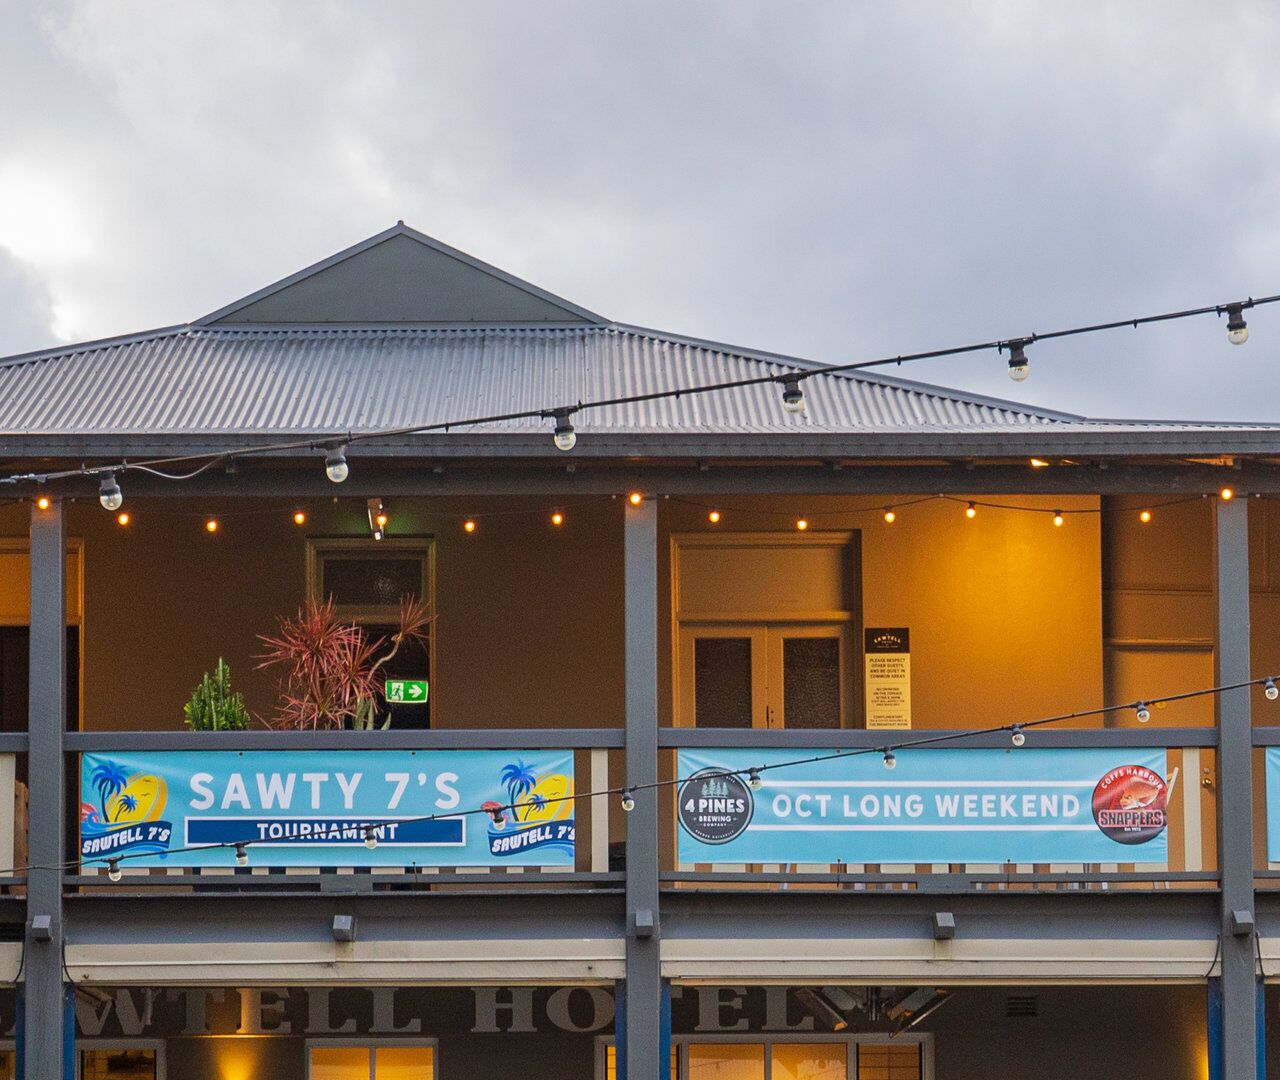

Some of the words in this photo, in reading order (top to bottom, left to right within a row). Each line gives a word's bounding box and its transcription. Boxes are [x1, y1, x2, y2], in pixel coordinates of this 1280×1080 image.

[189, 772, 363, 810] SAWTY
[384, 772, 461, 810] 7'S
[1101, 769, 1125, 789] COFFS
[1126, 768, 1163, 790] HARBOUR
[685, 799, 695, 813] 4
[699, 799, 745, 813] PINES
[771, 794, 831, 818] OCT
[843, 794, 924, 818] LONG
[935, 794, 1081, 818] WEEKEND
[1100, 811, 1162, 825] SNAPPERS
[82, 827, 143, 854] SAWTELL
[147, 825, 171, 843] 7'S
[257, 822, 398, 841] TOURNAMENT
[491, 827, 554, 854] SAWTELL
[470, 985, 815, 1033] HOEL
